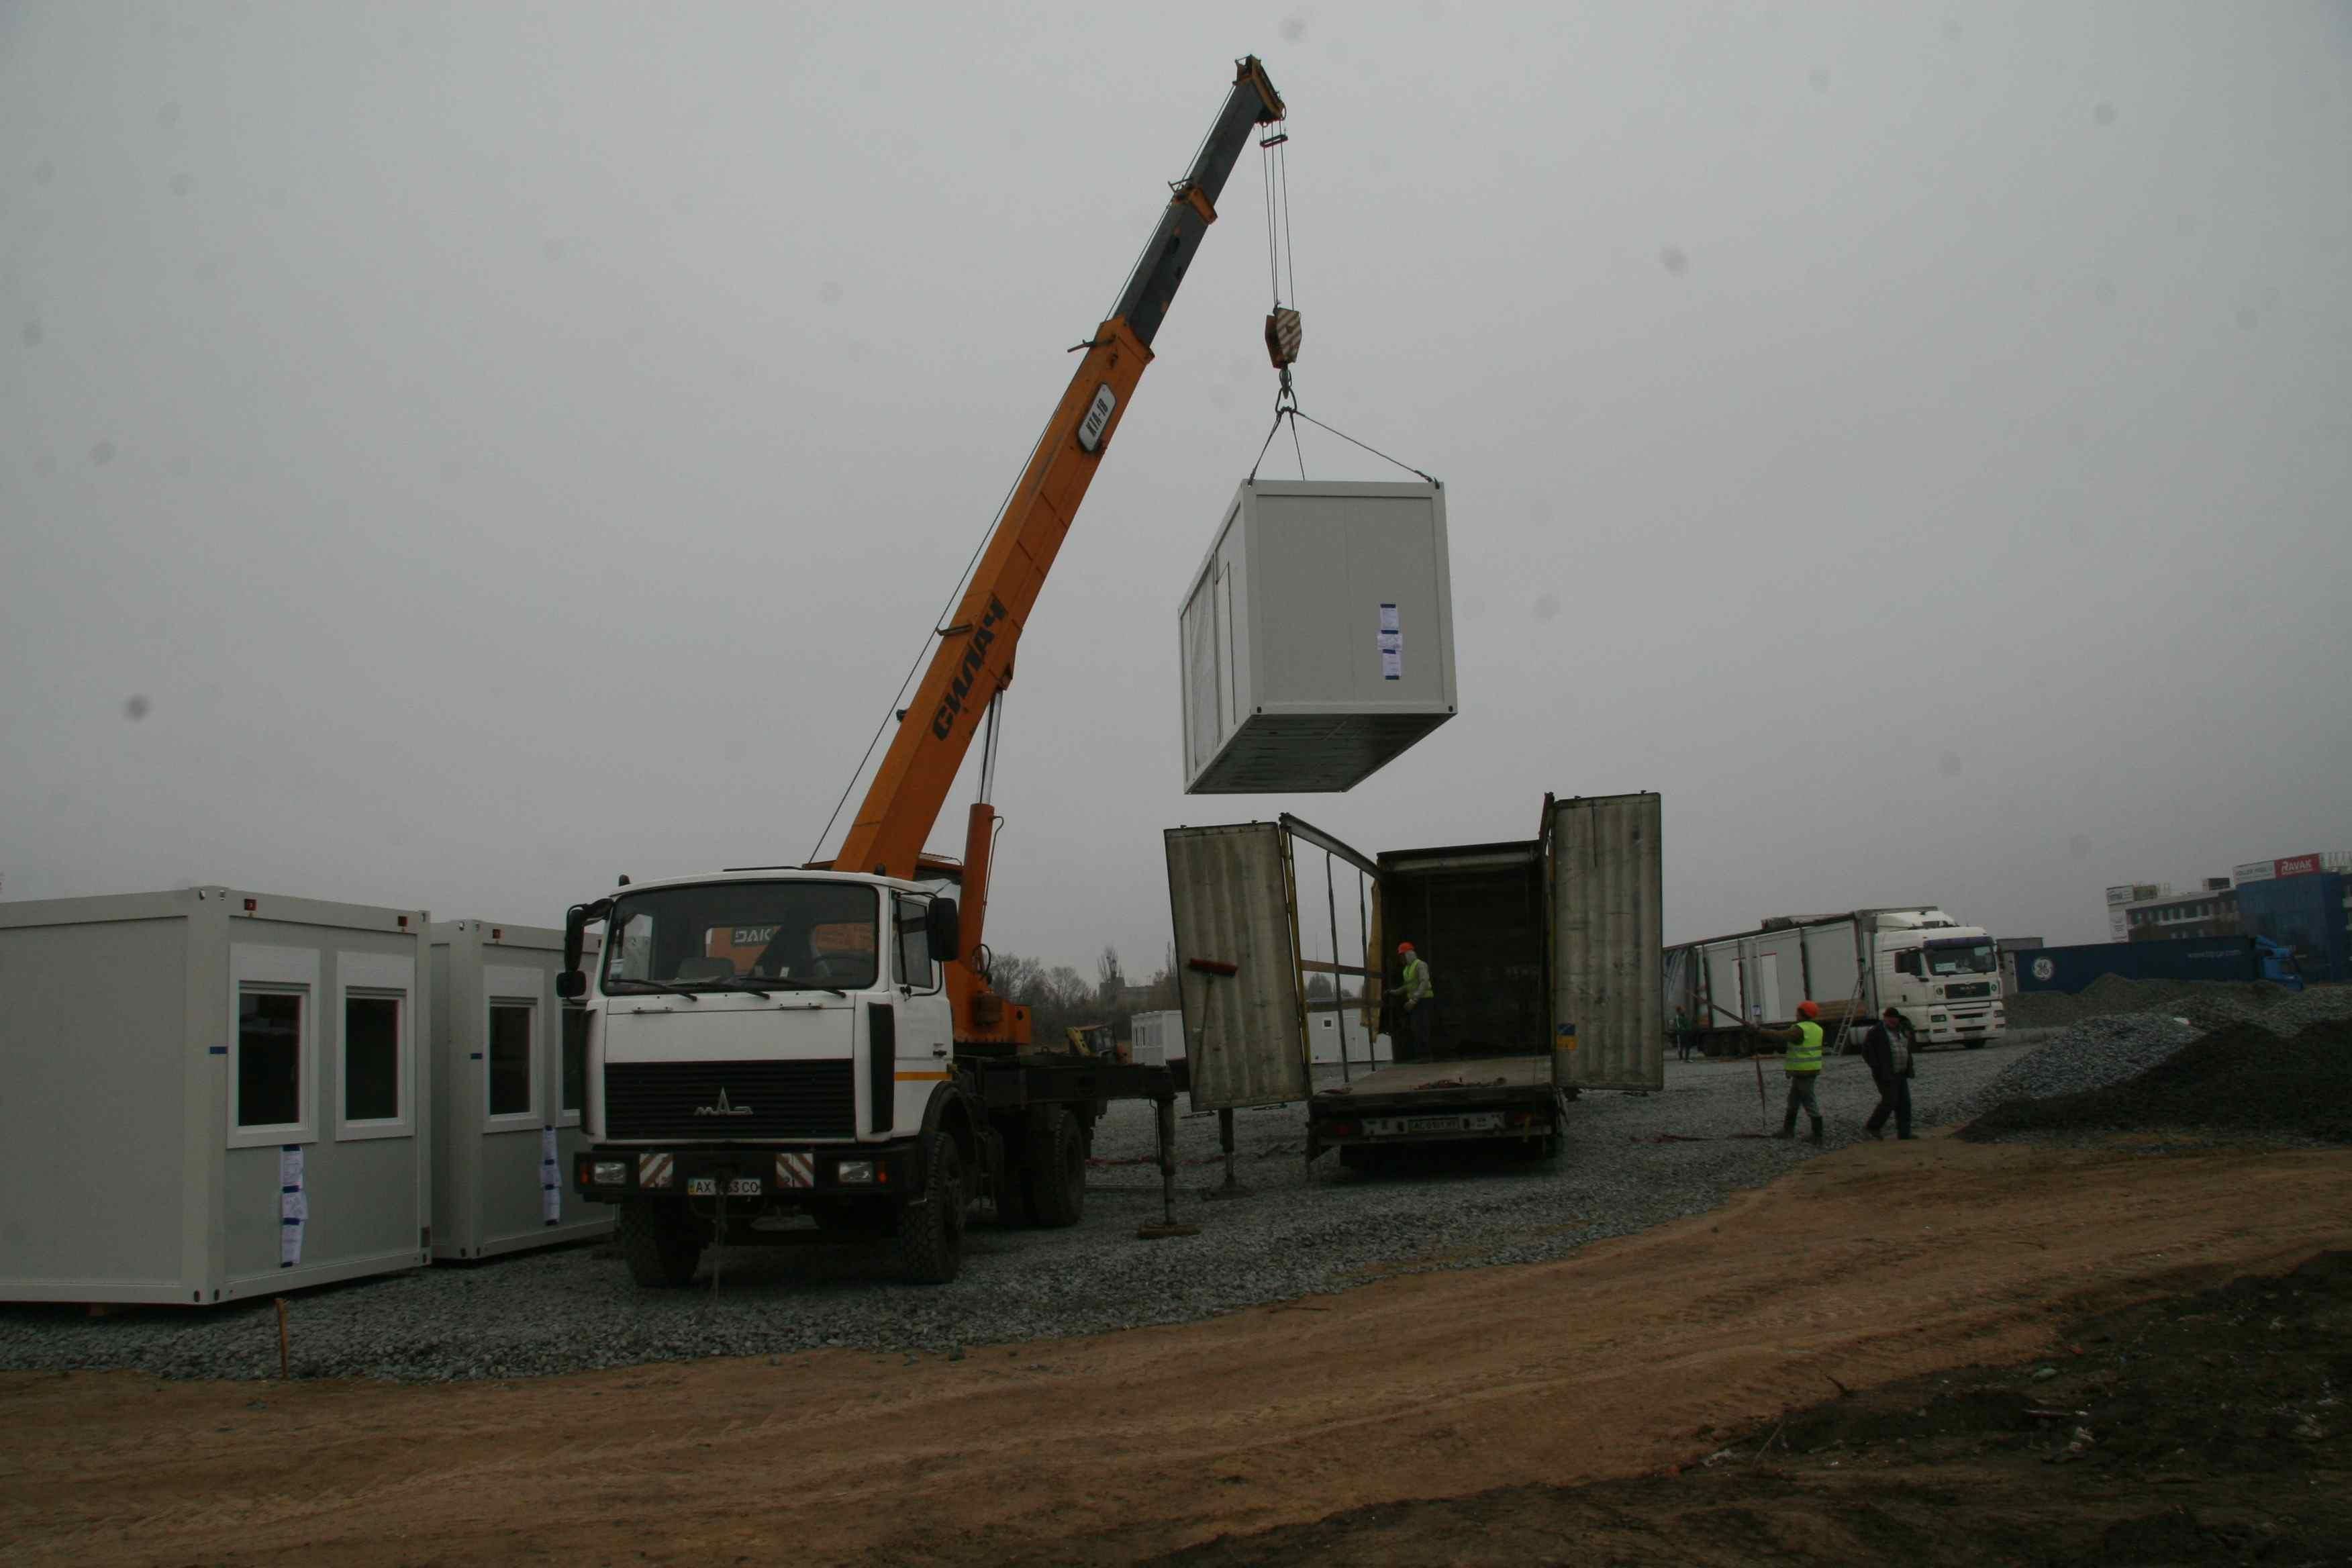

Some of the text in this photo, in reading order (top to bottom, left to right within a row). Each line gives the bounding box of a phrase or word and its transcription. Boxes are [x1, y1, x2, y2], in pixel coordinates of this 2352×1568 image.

[932, 593, 1008, 741] СИЛАЧ
[2282, 859, 2312, 873] RAVAK
[695, 1181, 711, 1193] AX
